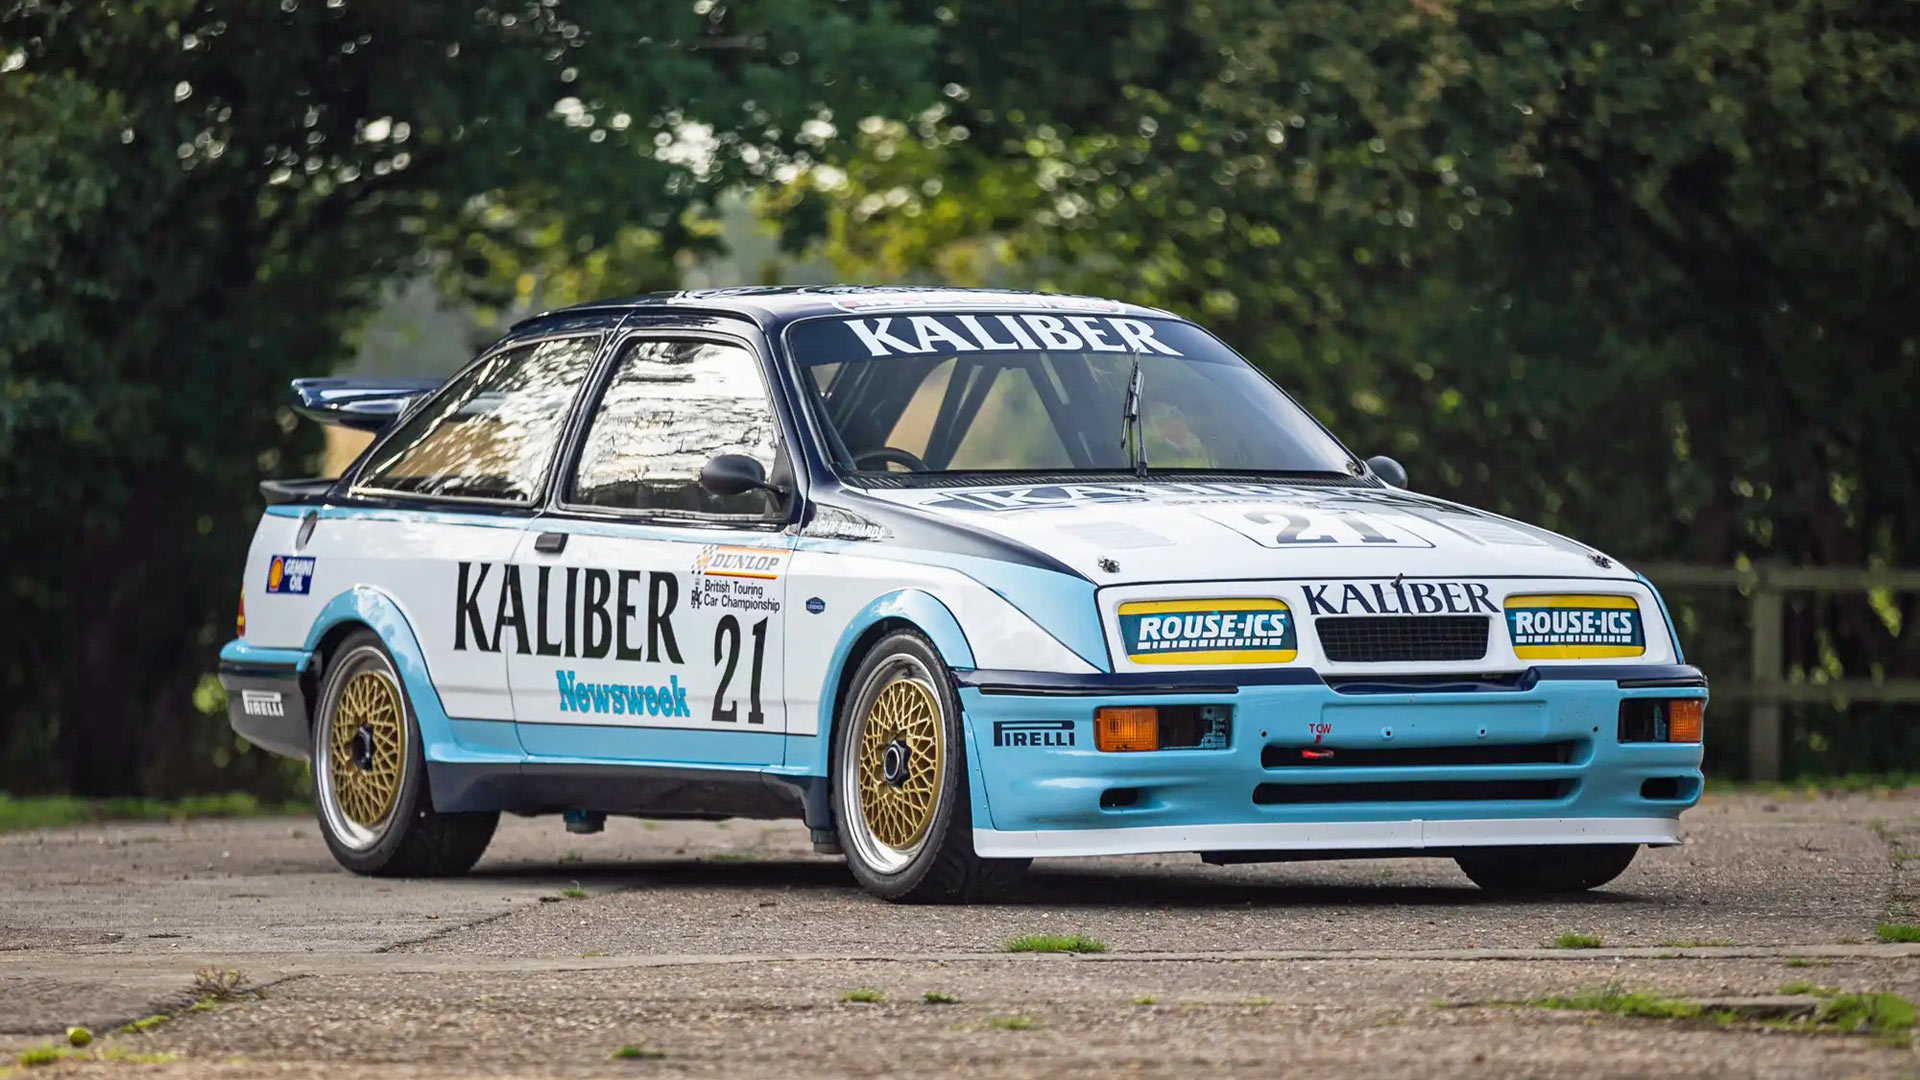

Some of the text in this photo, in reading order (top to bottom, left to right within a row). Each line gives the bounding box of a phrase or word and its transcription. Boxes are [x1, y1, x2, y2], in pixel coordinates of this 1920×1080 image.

[842, 314, 1185, 357] KALIBER
[1242, 511, 1398, 544] 21
[284, 558, 314, 576] GEMINI
[711, 553, 780, 571] DUNLOP
[289, 575, 303, 592] OIL
[704, 579, 764, 599] British Touring
[453, 561, 685, 664] KALIBER
[703, 593, 780, 613] Car Championship
[1300, 582, 1504, 616] KALIBER
[1139, 613, 1286, 641] ROUSE-ICS
[1515, 611, 1633, 634] ROUSE-ICS
[711, 613, 769, 725] 21
[242, 689, 284, 717] PIRELLI
[556, 669, 690, 718] Newsweek
[993, 720, 1075, 747] PIRELLI
[1308, 723, 1332, 734] TOW
